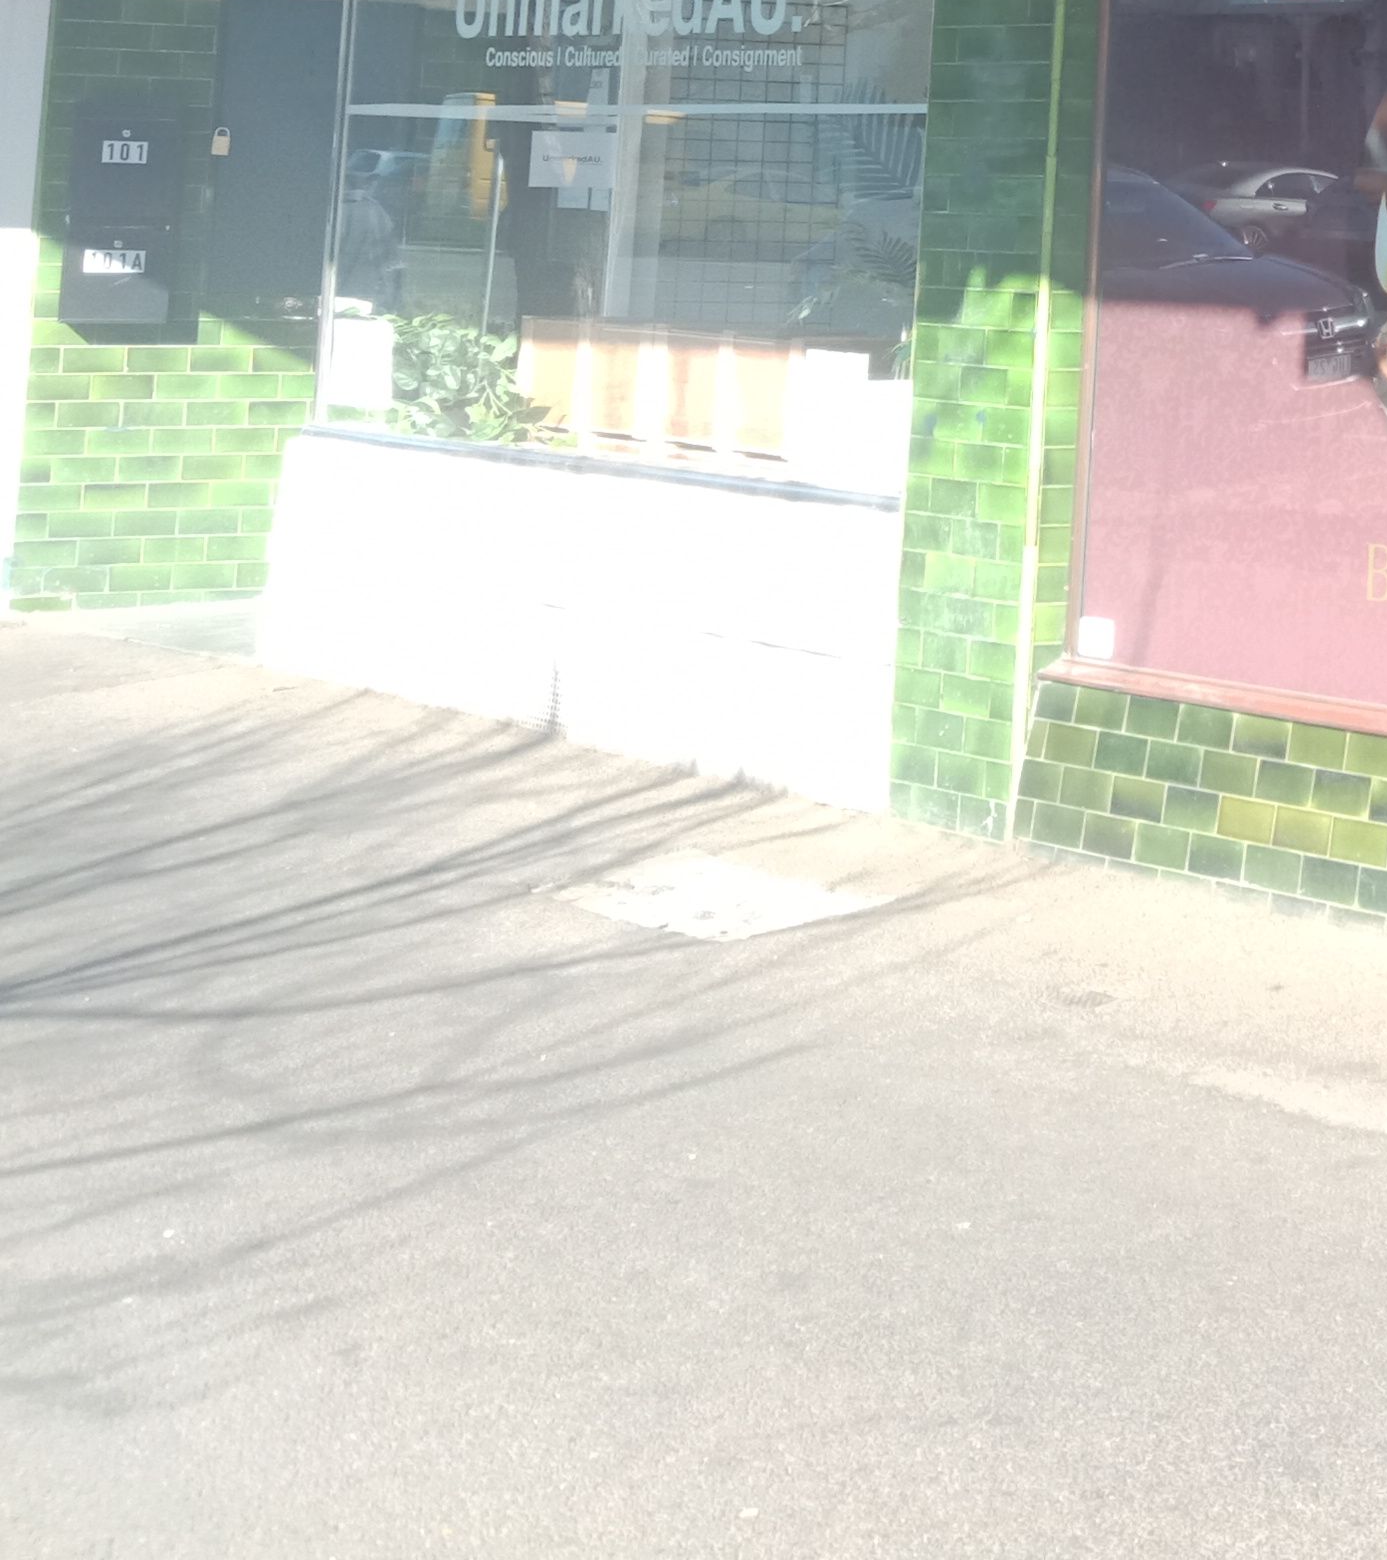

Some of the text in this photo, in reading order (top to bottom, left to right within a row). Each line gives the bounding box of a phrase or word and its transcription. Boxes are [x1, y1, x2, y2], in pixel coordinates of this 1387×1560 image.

[485, 46, 554, 68] Conscious
[564, 44, 624, 67] Cultured
[702, 45, 803, 72] Consignment
[107, 143, 145, 162] 101
